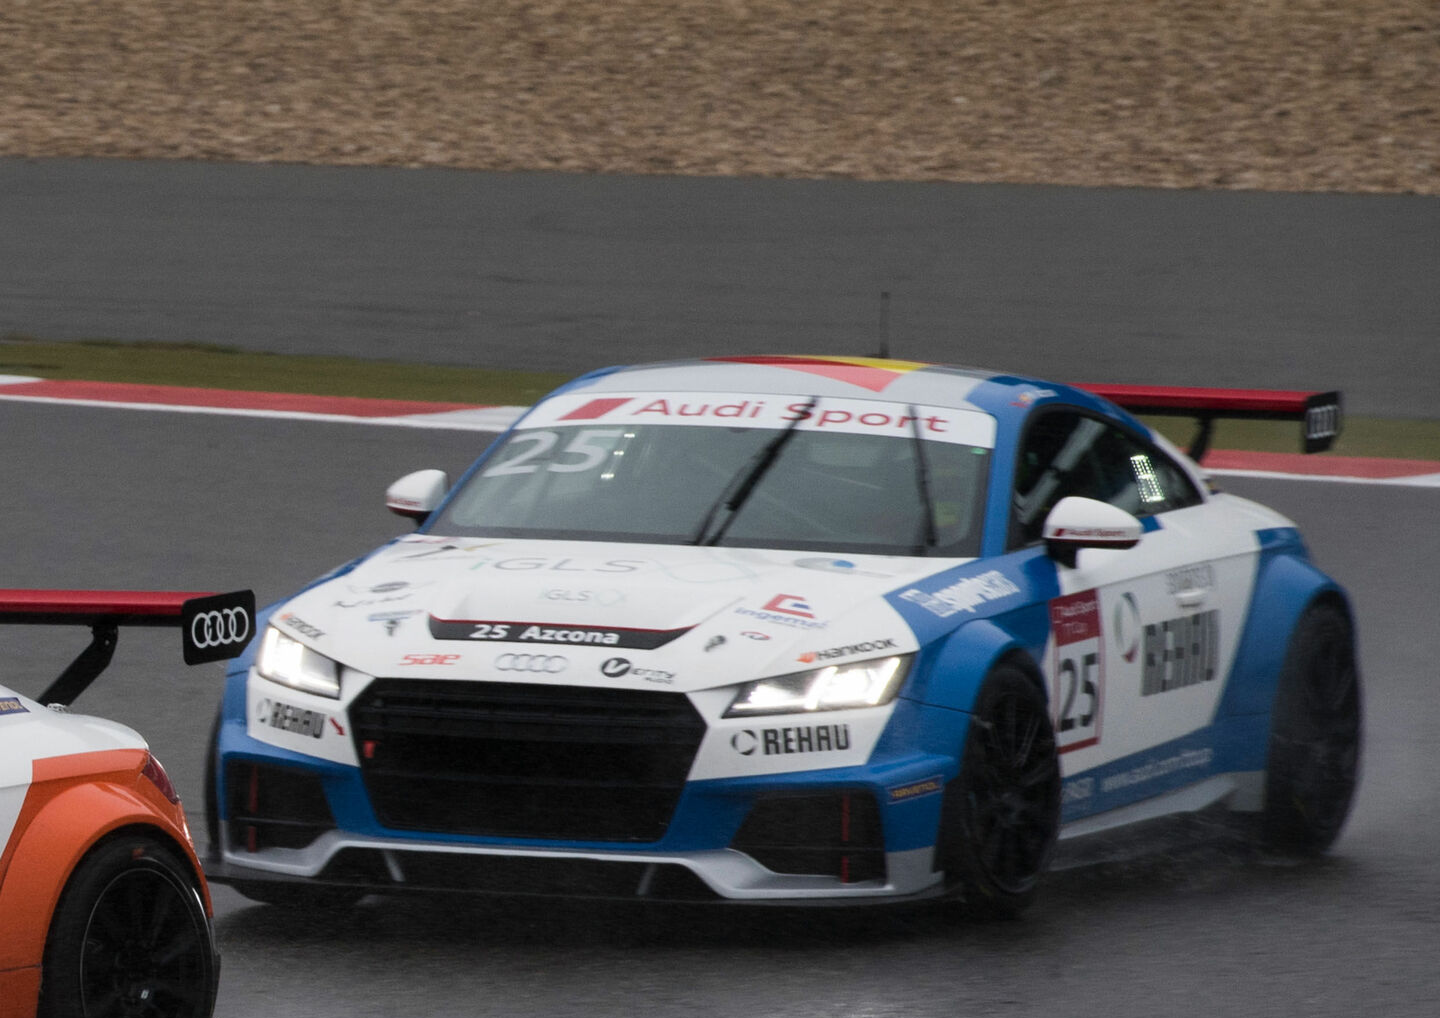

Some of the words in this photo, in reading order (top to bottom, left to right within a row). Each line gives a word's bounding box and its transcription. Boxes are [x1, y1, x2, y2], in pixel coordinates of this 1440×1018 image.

[631, 398, 765, 420] Audi
[779, 401, 951, 433] Sport
[483, 429, 623, 477] 25
[469, 624, 511, 640] 25
[520, 625, 621, 645] Azcona
[1059, 653, 1099, 733] 25
[763, 724, 851, 756] REHAU
